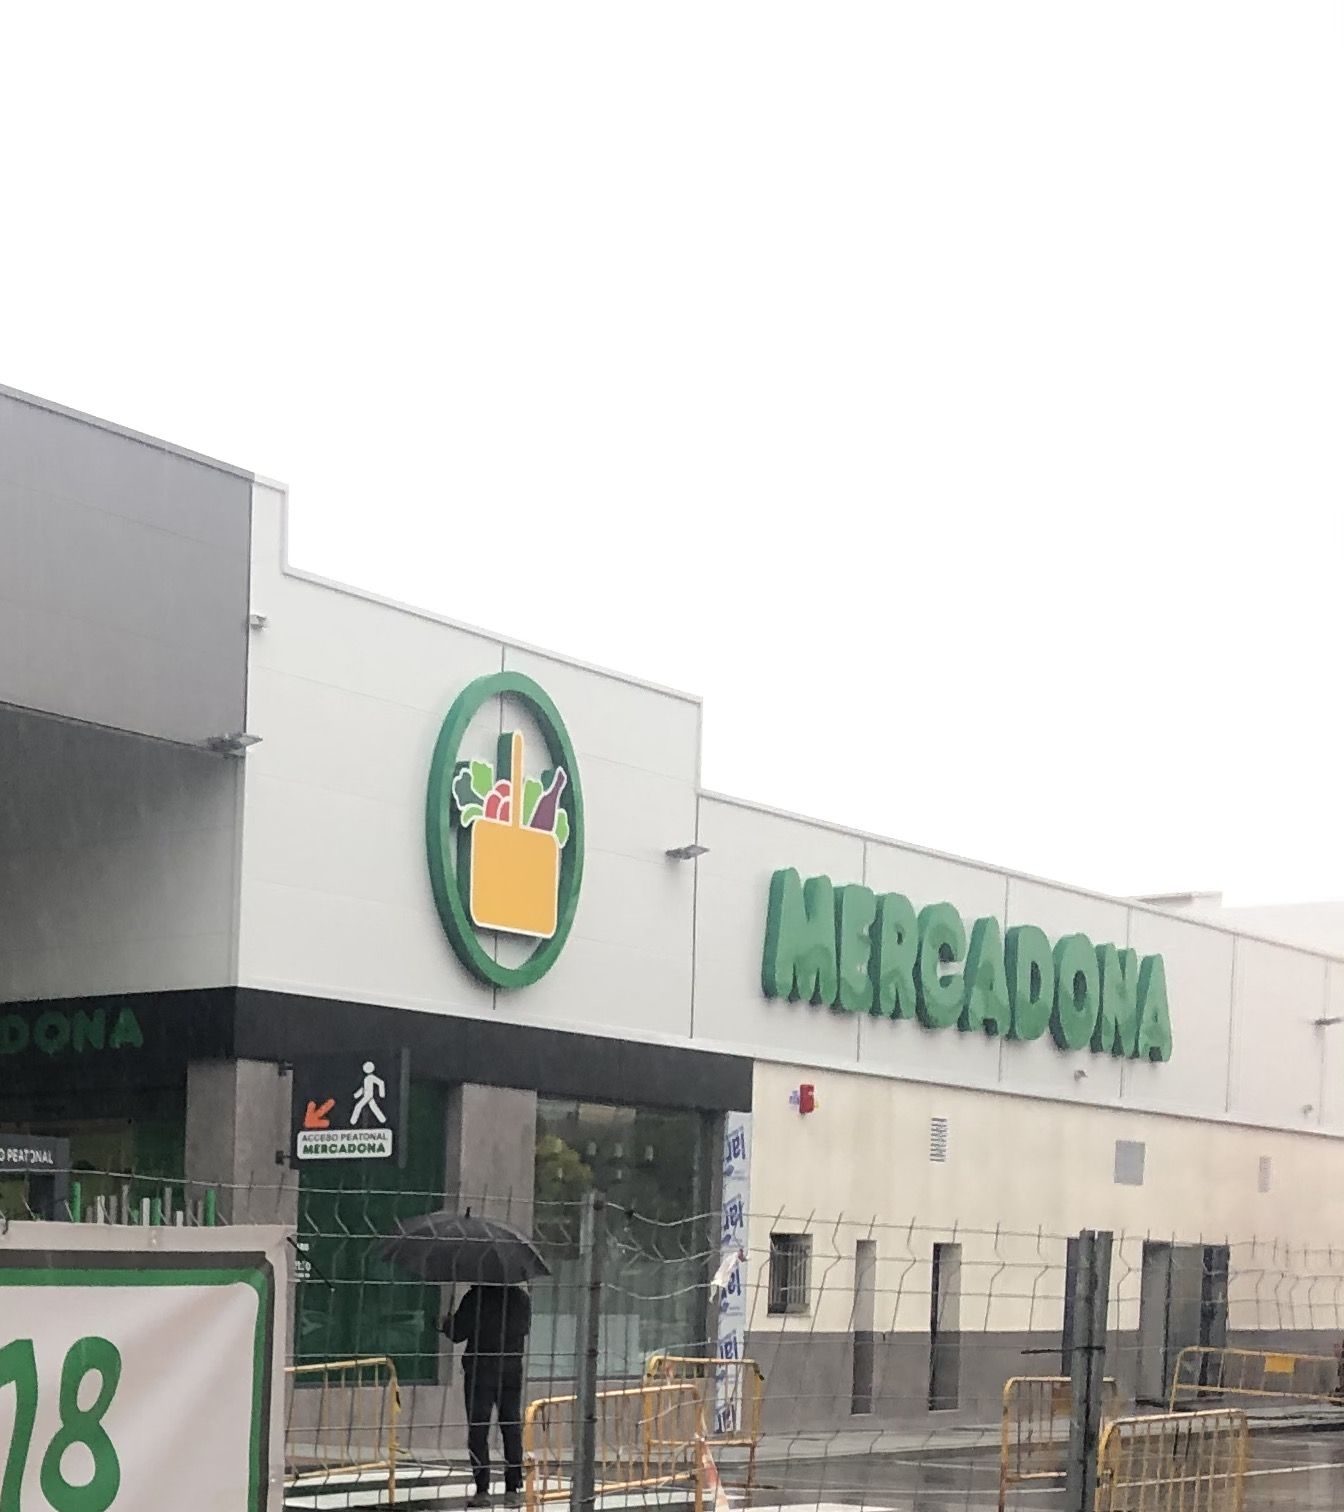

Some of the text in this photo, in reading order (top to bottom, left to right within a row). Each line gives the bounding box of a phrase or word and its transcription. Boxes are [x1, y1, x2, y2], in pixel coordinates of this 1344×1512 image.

[762, 867, 1173, 1063] MERCADONA
[303, 1132, 387, 1142] ACCESO PEATONAL
[303, 1143, 386, 1154] MERCADONA
[7, 1148, 53, 1164] PEATONAL
